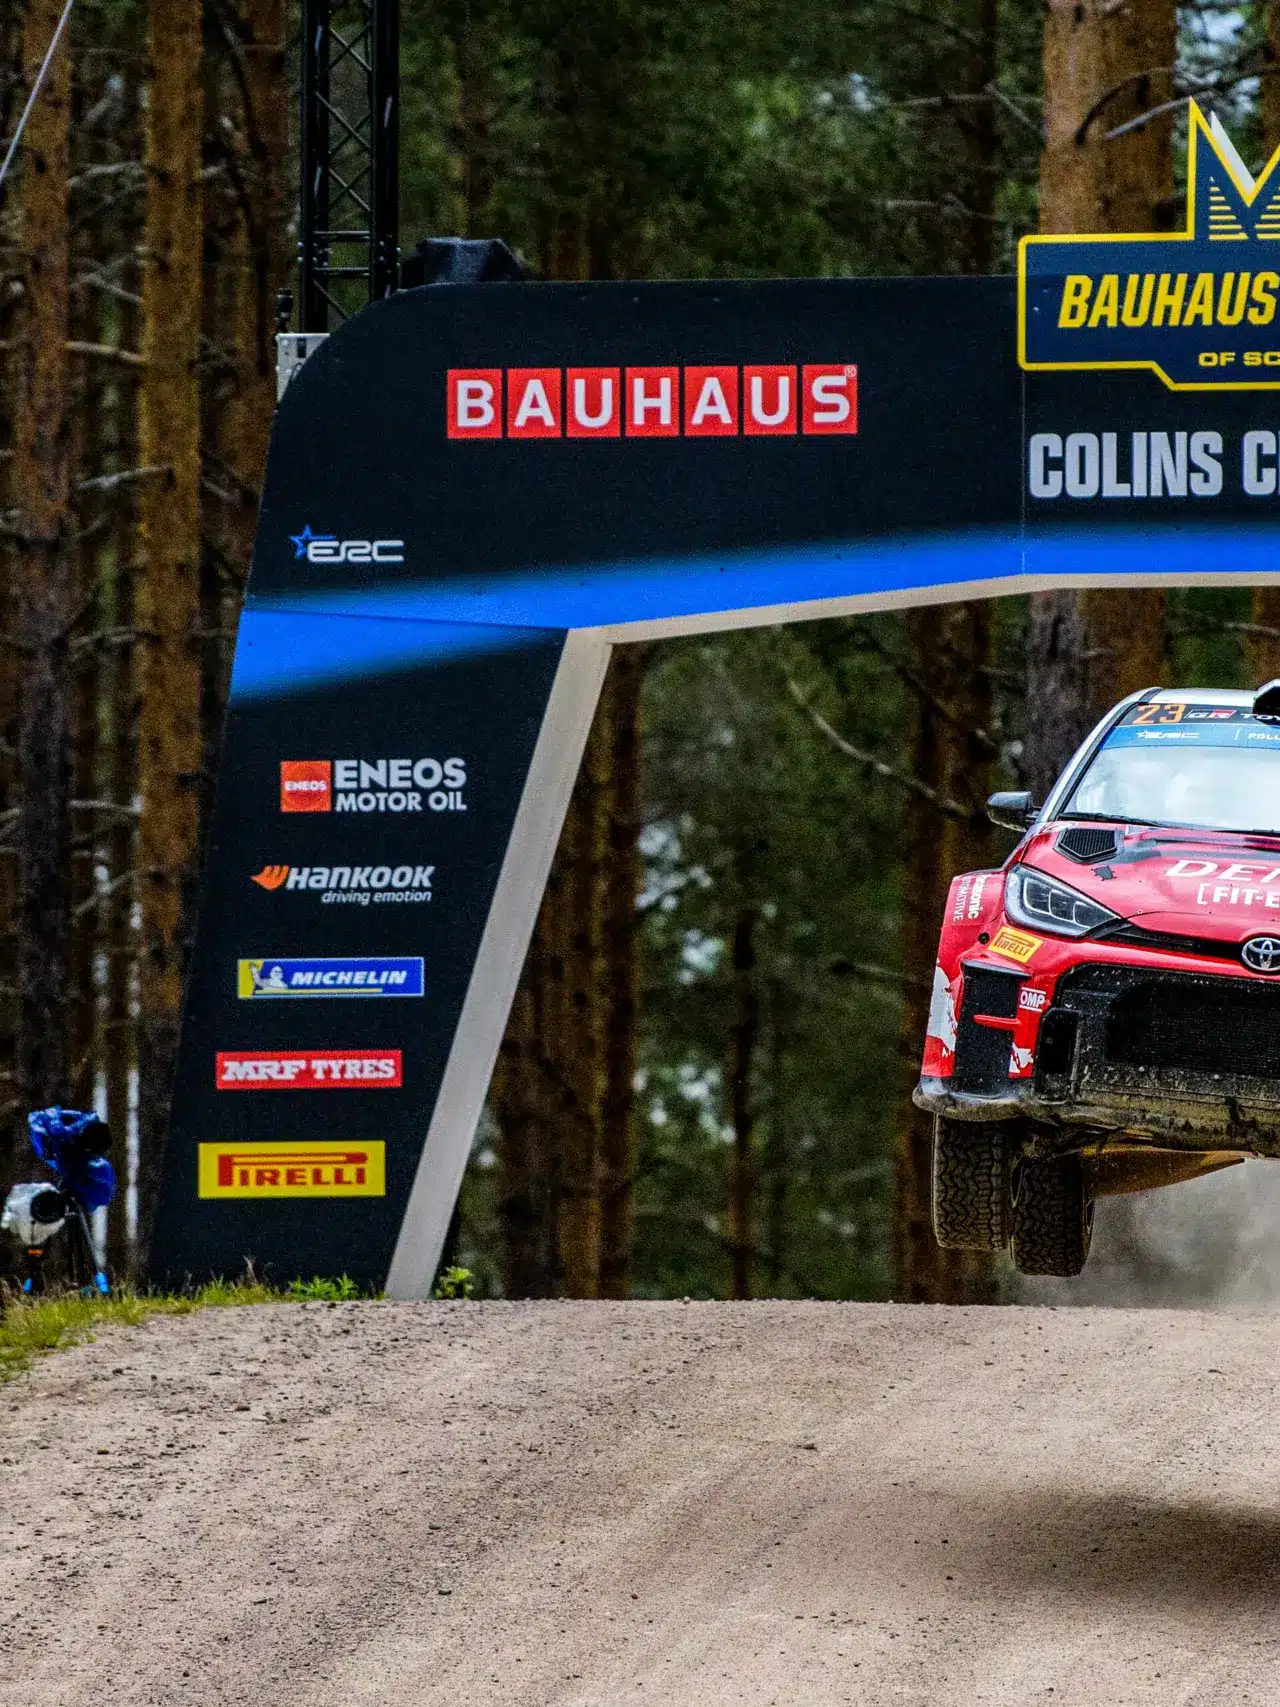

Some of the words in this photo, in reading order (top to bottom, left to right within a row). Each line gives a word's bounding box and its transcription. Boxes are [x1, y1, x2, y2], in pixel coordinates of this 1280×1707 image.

[1058, 273, 1279, 328] BAUHAUS
[1198, 352, 1236, 367] OF
[456, 376, 851, 427] BAUHAUS
[1029, 431, 1223, 498] COLINS
[307, 540, 404, 562] ERC
[1132, 703, 1186, 725] 23
[335, 758, 467, 788] ENEOS
[285, 780, 327, 791] ENEOS
[337, 793, 422, 811] MOTOR
[429, 792, 467, 811] OIL
[321, 890, 370, 906] driving
[374, 890, 432, 902] emotion
[994, 932, 1035, 956] PIRELLI
[291, 970, 408, 985] MICHELIN
[1021, 992, 1046, 1008] OMP
[222, 1060, 307, 1082] MRF
[311, 1058, 396, 1080] TYRES
[217, 1153, 369, 1187] PIRELLI
